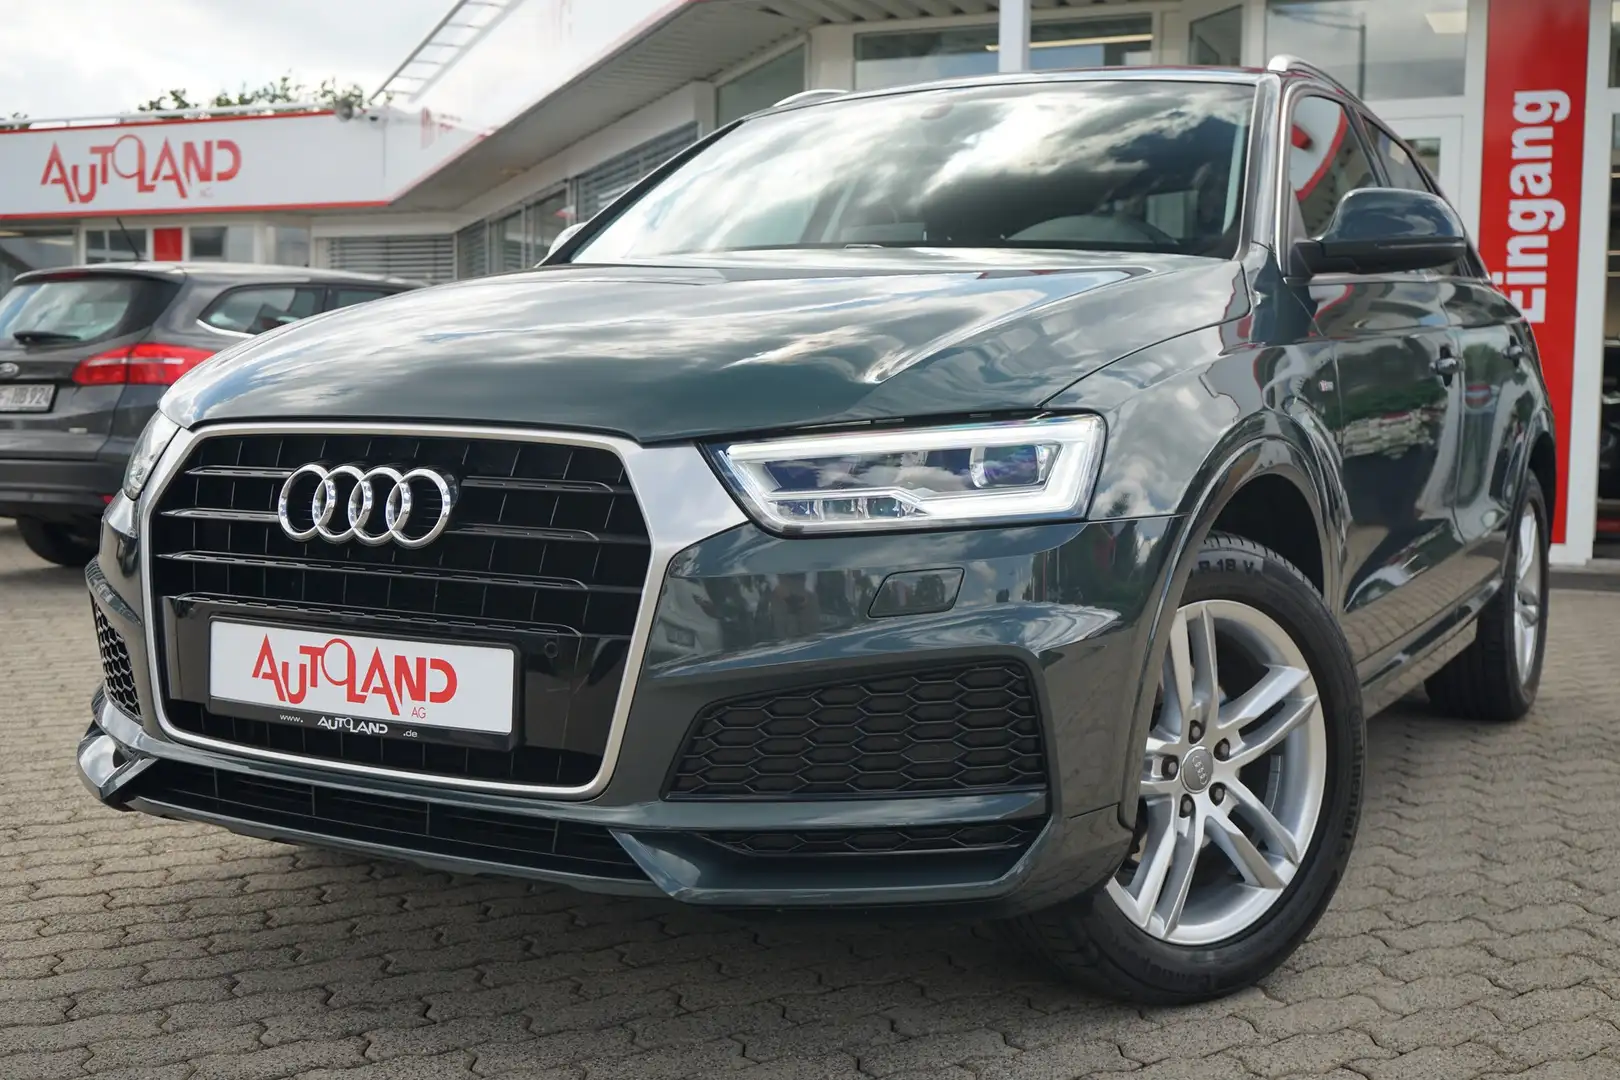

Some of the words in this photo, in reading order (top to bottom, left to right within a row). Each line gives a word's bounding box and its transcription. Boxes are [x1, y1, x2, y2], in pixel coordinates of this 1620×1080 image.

[41, 134, 242, 203] AUTOLAND
[1216, 558, 1236, 573] 18
[1243, 560, 1254, 574] V
[252, 633, 457, 716] AUTOLAND
[411, 706, 426, 719] AG
[280, 713, 304, 723] www.
[318, 716, 388, 735] AUTOLAND
[403, 729, 418, 738] .de
